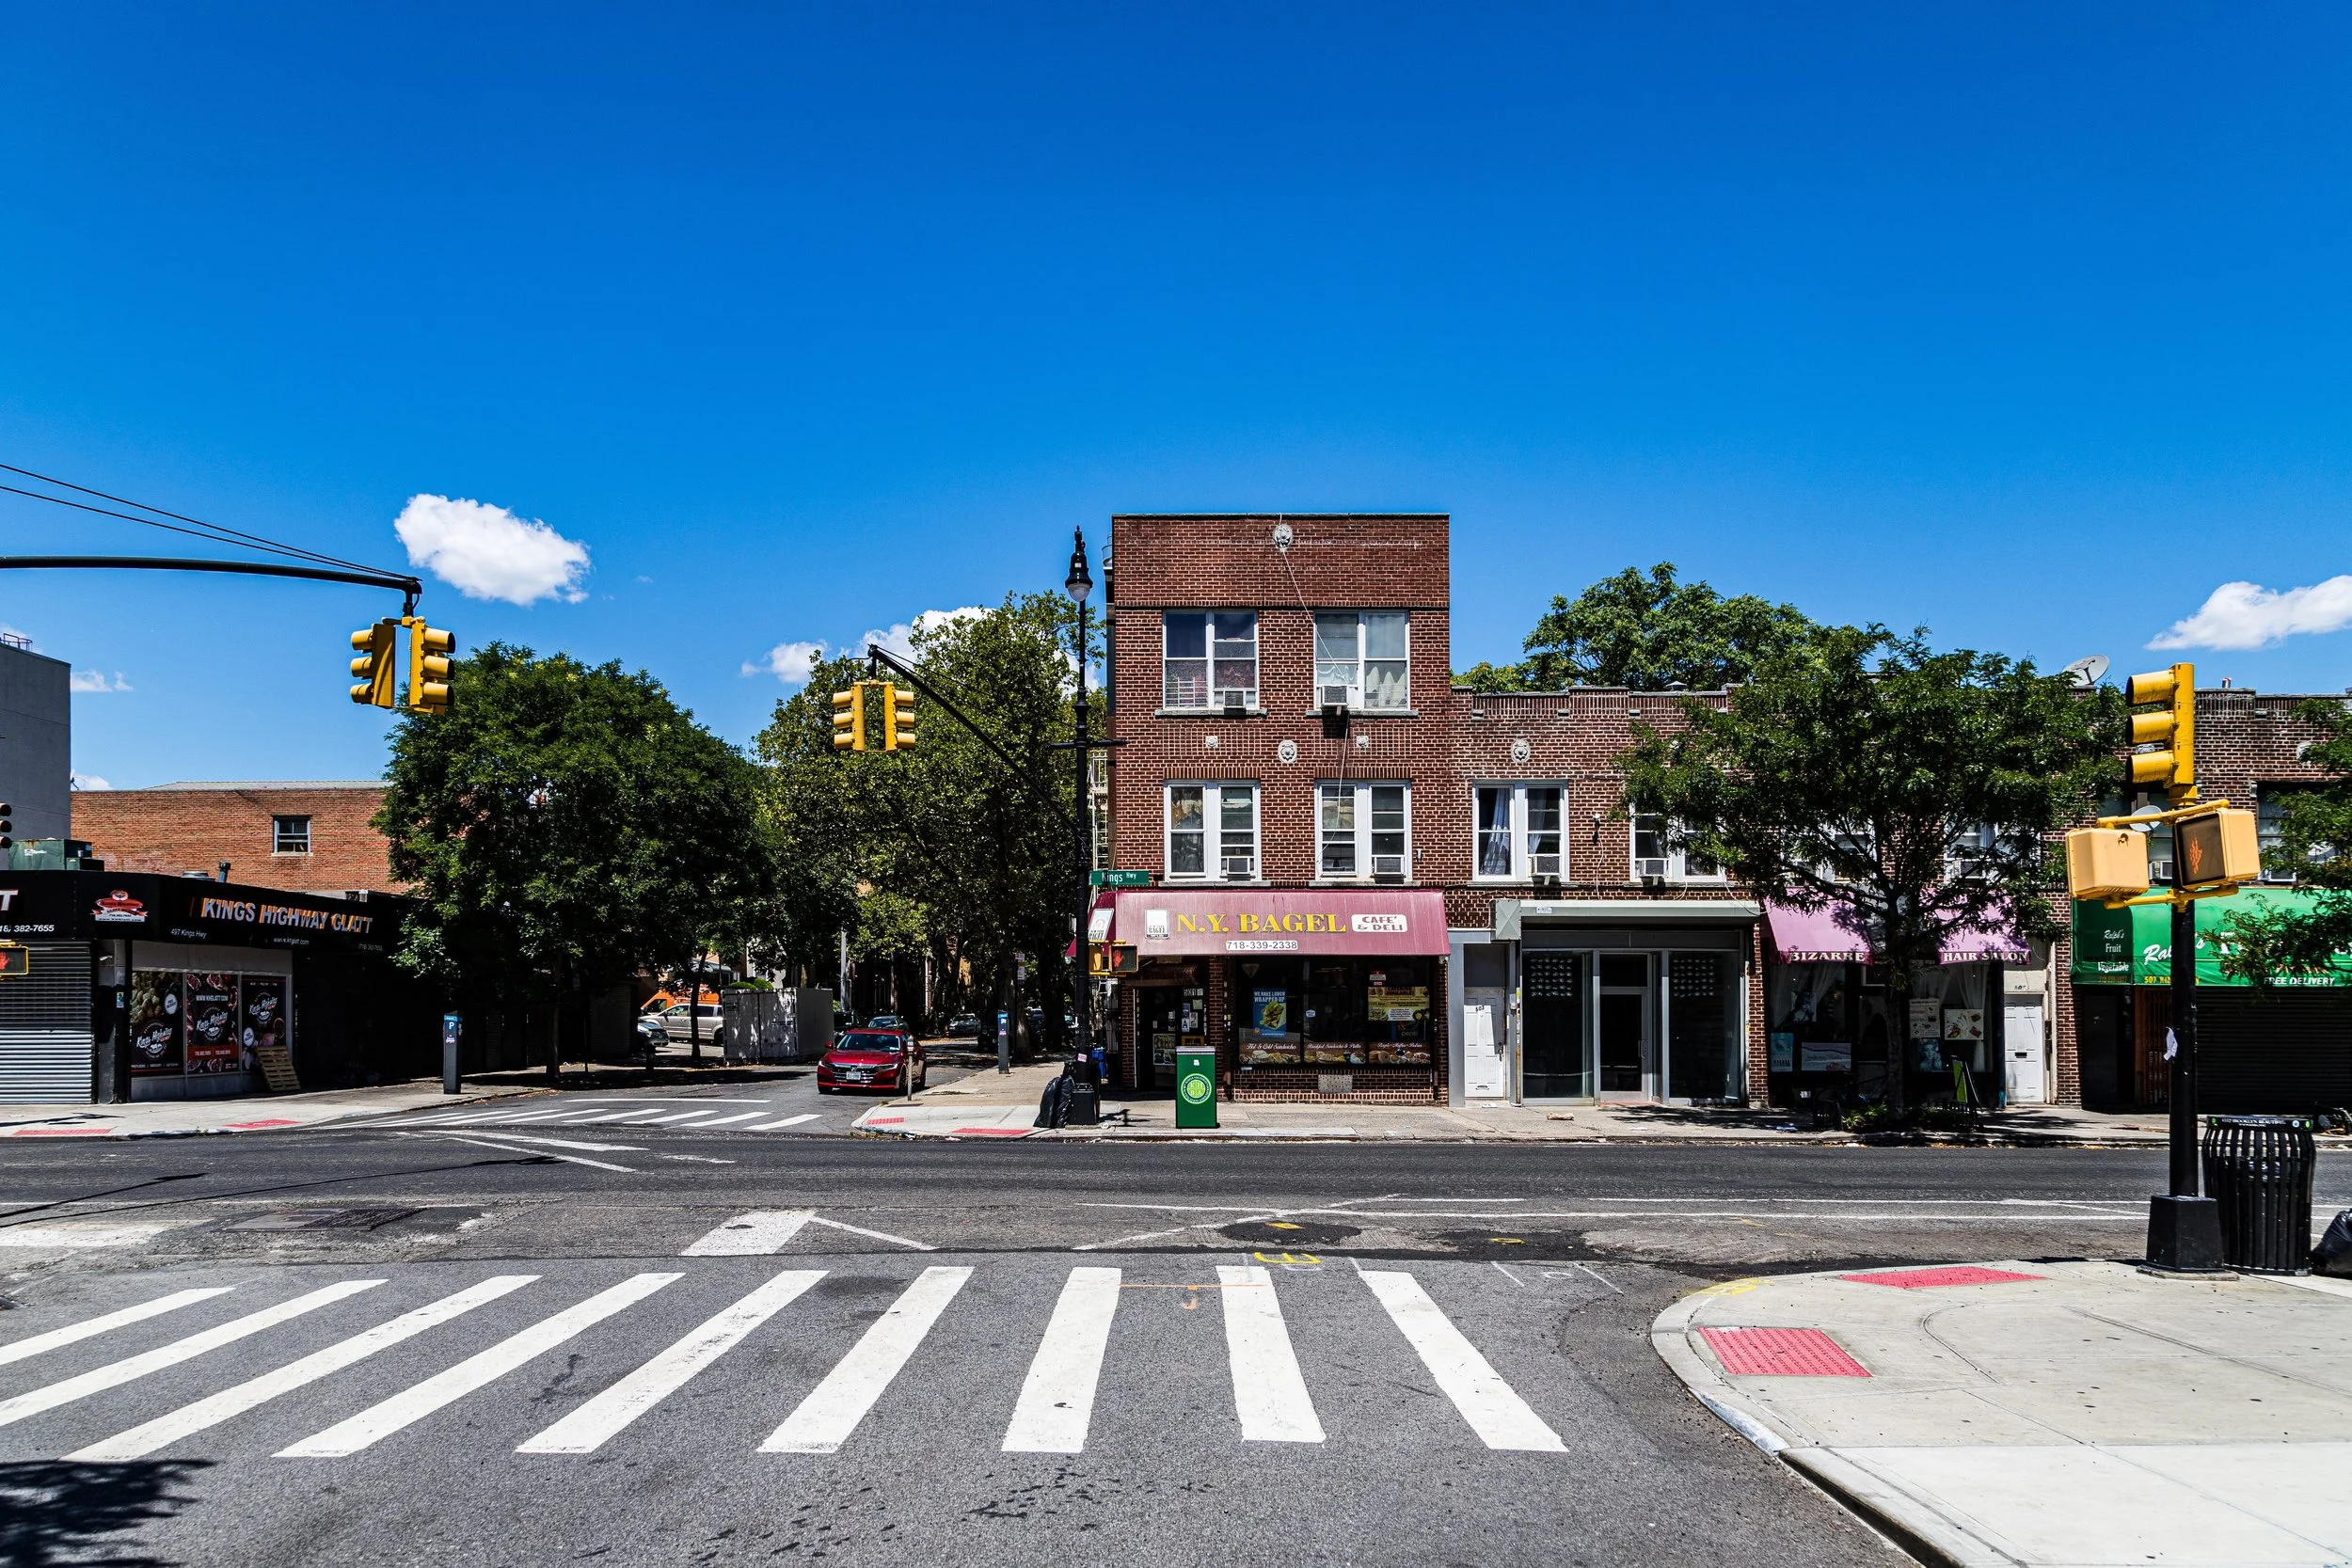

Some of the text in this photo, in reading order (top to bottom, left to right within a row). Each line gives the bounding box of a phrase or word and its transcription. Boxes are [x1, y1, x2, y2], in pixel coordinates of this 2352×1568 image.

[1102, 872, 1123, 885] Kings
[201, 897, 373, 934] KINGS HIGHWAY GLATT
[1177, 913, 1347, 933] N.Y. BAGEL
[182, 929, 195, 938] Kings
[197, 930, 207, 939] Hwy
[2103, 929, 2124, 941] Ralph's
[2106, 943, 2122, 953] Fruit
[1790, 952, 1865, 961] BIZARRE
[1944, 952, 2026, 961] HAIR SALON
[2098, 962, 2129, 974] Vegetable
[449, 1022, 454, 1030] P
